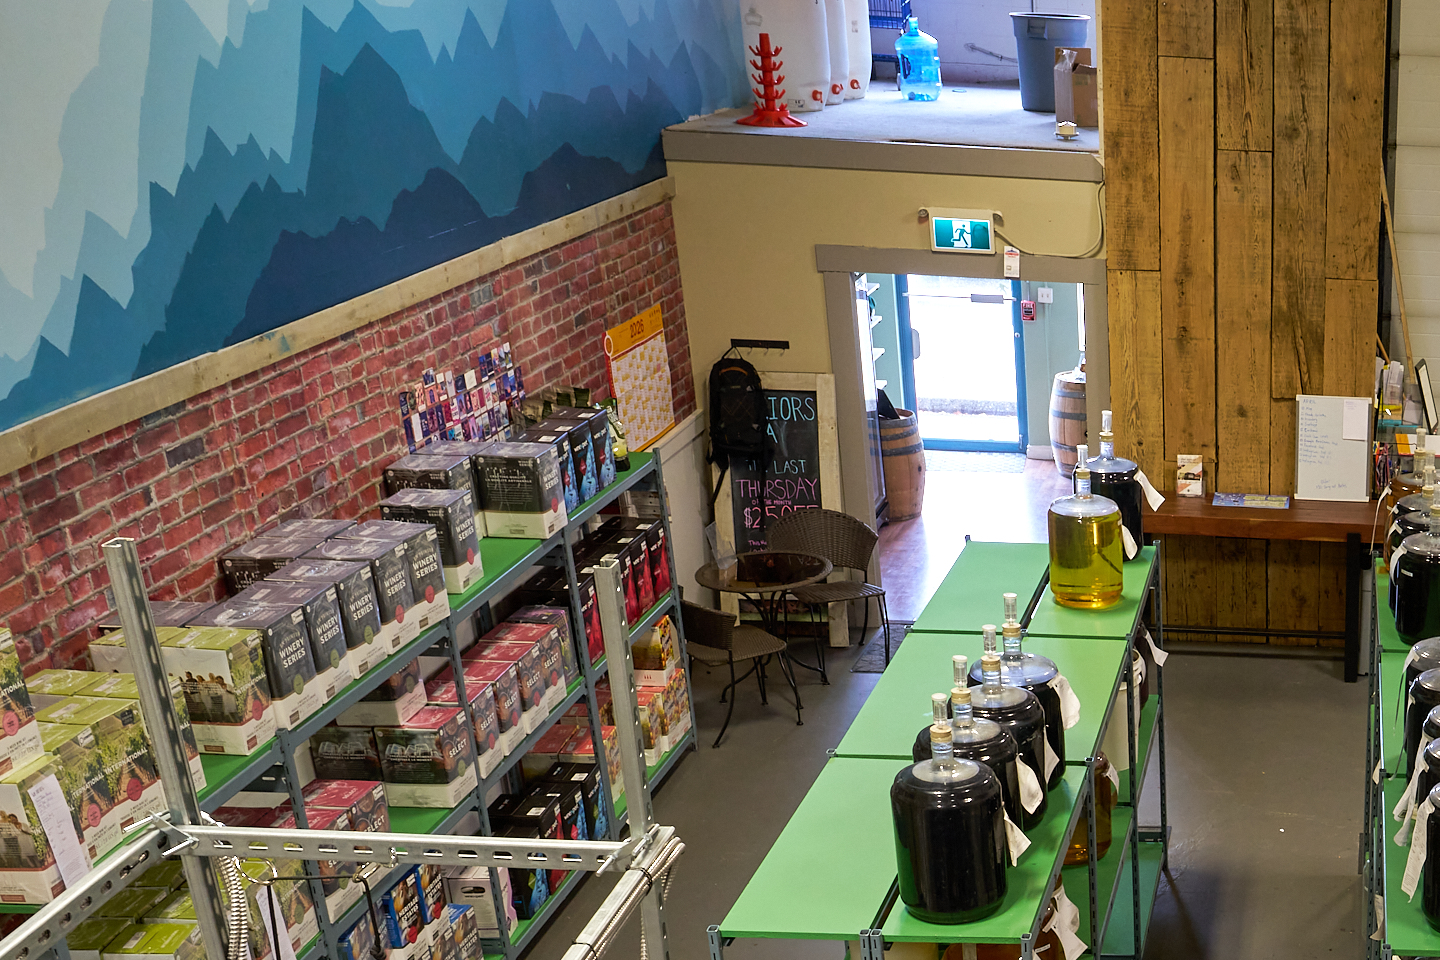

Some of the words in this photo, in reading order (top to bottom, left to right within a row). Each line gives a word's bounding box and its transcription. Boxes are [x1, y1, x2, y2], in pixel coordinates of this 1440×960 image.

[630, 318, 645, 339] 2026
[767, 396, 816, 422] IORS
[774, 459, 806, 475] LAST
[455, 517, 473, 535] WINERY
[458, 525, 475, 541] SERIES
[412, 553, 437, 571] WINERY
[415, 562, 438, 579] SERIES
[384, 569, 405, 588] WINERY
[386, 579, 407, 597] SERIES
[349, 593, 372, 612] WINERY
[353, 602, 374, 621] SERIES
[316, 614, 338, 635] WINERY
[319, 624, 340, 644] SERIES
[279, 636, 305, 659] WINERY
[283, 647, 306, 669] SERIES
[543, 652, 559, 668] SELECT
[526, 672, 542, 688] SELECT
[0, 680, 25, 700] ATIONAL
[504, 691, 519, 708] SELECT
[480, 713, 496, 730] SELECT
[449, 738, 467, 758] SELECT
[425, 874, 442, 893] HERITAGE
[427, 882, 443, 899] ESTATES
[399, 896, 419, 917] HERITAGE
[401, 904, 419, 922] ESTATES
[458, 928, 478, 948] HERITAGE
[461, 935, 478, 953] ESTATES
